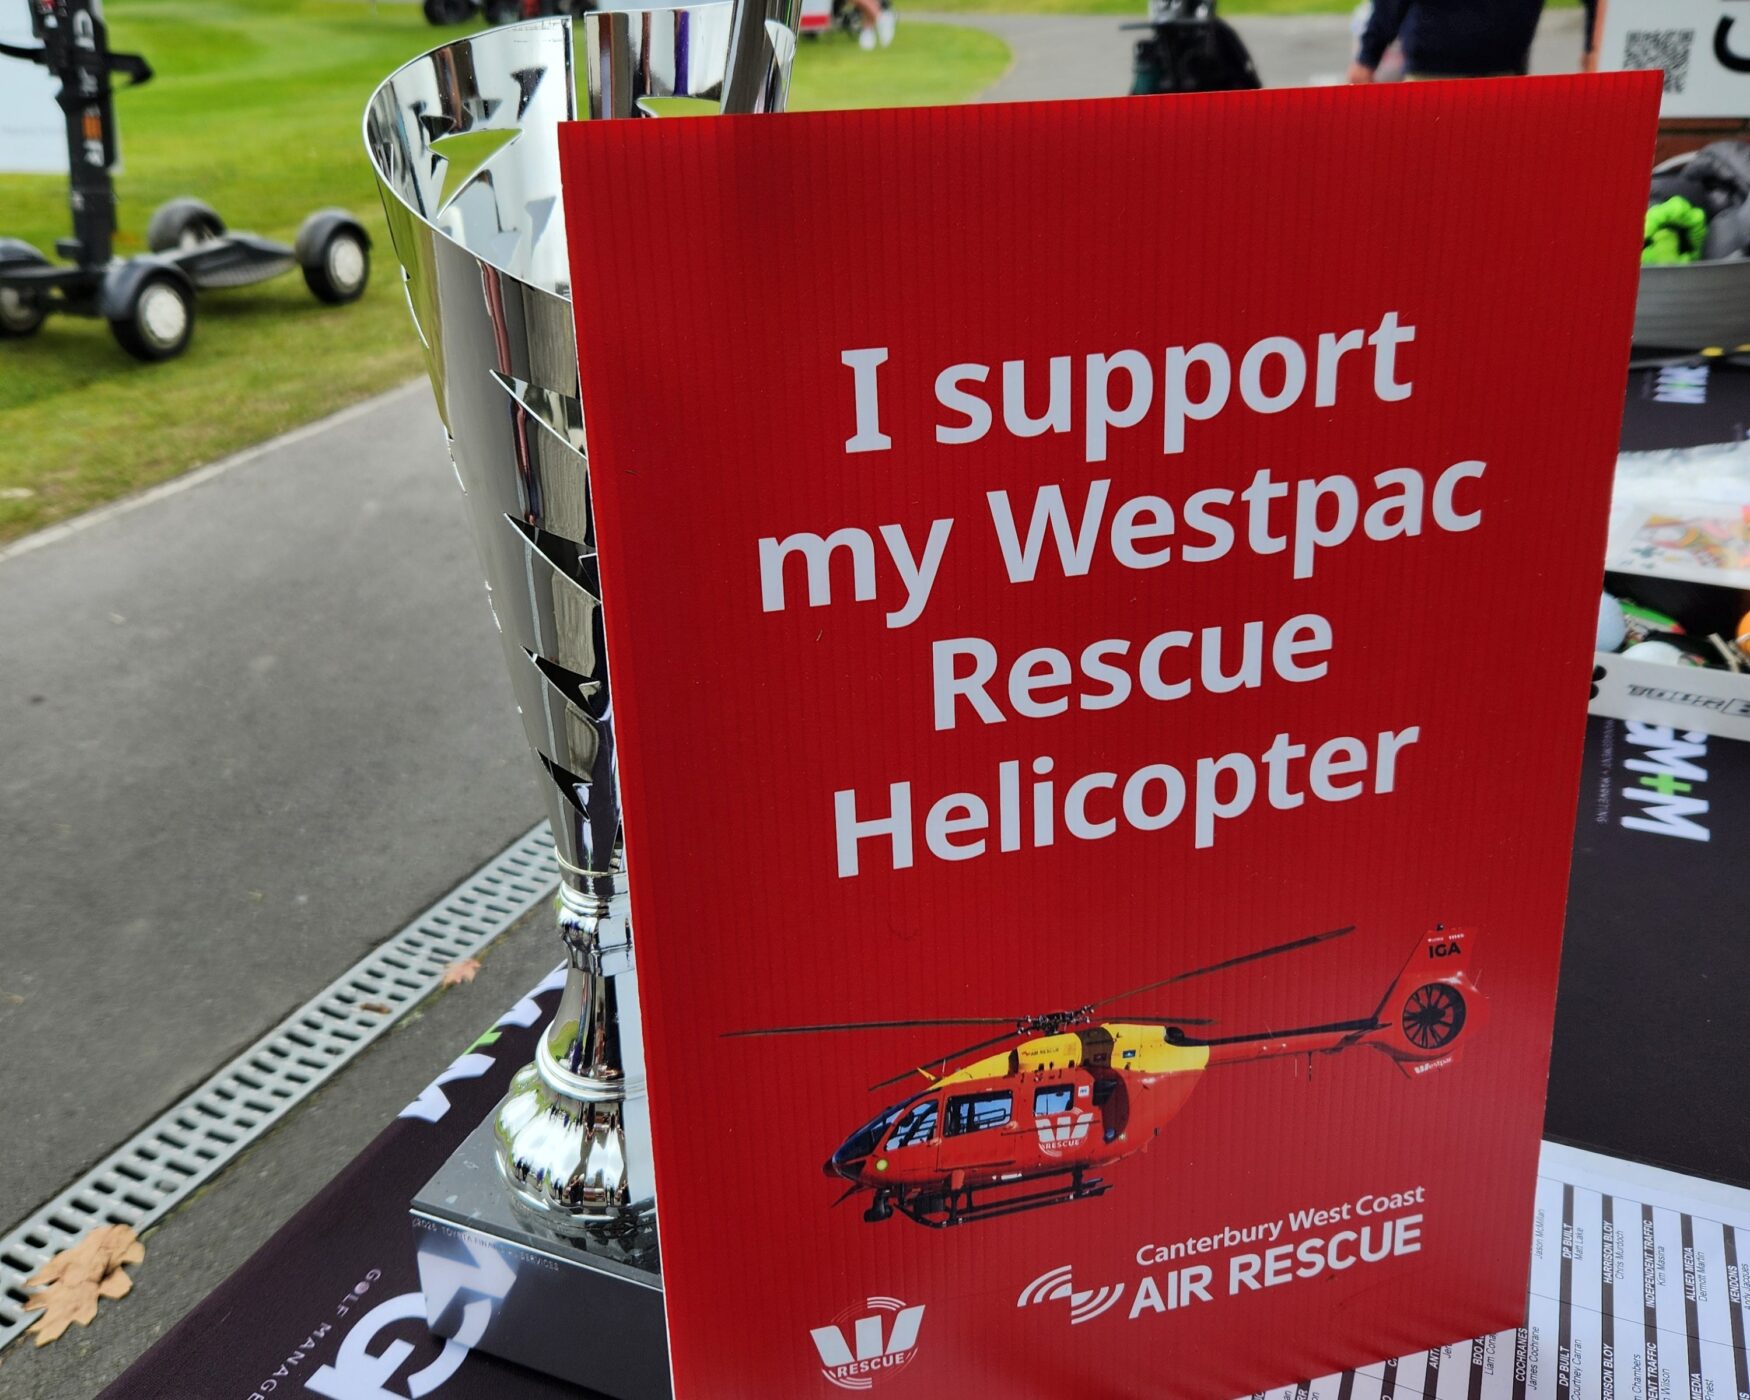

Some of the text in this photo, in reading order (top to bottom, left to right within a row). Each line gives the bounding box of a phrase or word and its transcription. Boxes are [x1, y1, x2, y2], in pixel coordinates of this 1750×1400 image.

[842, 312, 1415, 462] I support
[759, 461, 1486, 628] my Westpac
[932, 614, 1333, 731] Rescue
[835, 727, 1419, 878] Helicopter
[1428, 941, 1462, 959] IGA
[1045, 1139, 1080, 1150] RESCUE
[1136, 1186, 1425, 1266] Canterbury West Coast
[1562, 1223, 1573, 1259] DP BUILT
[1576, 1227, 1584, 1244] Lake
[1128, 1214, 1424, 1319] AIR RESCUE
[1603, 1220, 1613, 1284] HARRISON BLOY
[1614, 1260, 1625, 1280] Chris
[1642, 1219, 1656, 1308] INDEPENDENT TRAFFIC
[336, 1268, 382, 1319] GOLF
[1656, 1273, 1666, 1287] Kim
[1683, 1247, 1696, 1302] ALLIED MEDIA
[1727, 1265, 1742, 1303] KENDONS
[837, 1352, 905, 1378] RESCUE
[1472, 1346, 1484, 1366] BDO
[1484, 1355, 1495, 1376] Liam
[1515, 1327, 1529, 1382] COCHRANES
[1527, 1326, 1540, 1391] James Cochrane
[1558, 1346, 1571, 1387] DP BUILT
[1602, 1343, 1614, 1369] BLOY
[1631, 1353, 1642, 1395] Chambers
[1646, 1342, 1659, 1376] TRAFFIC
[1660, 1368, 1671, 1395] Wilson
